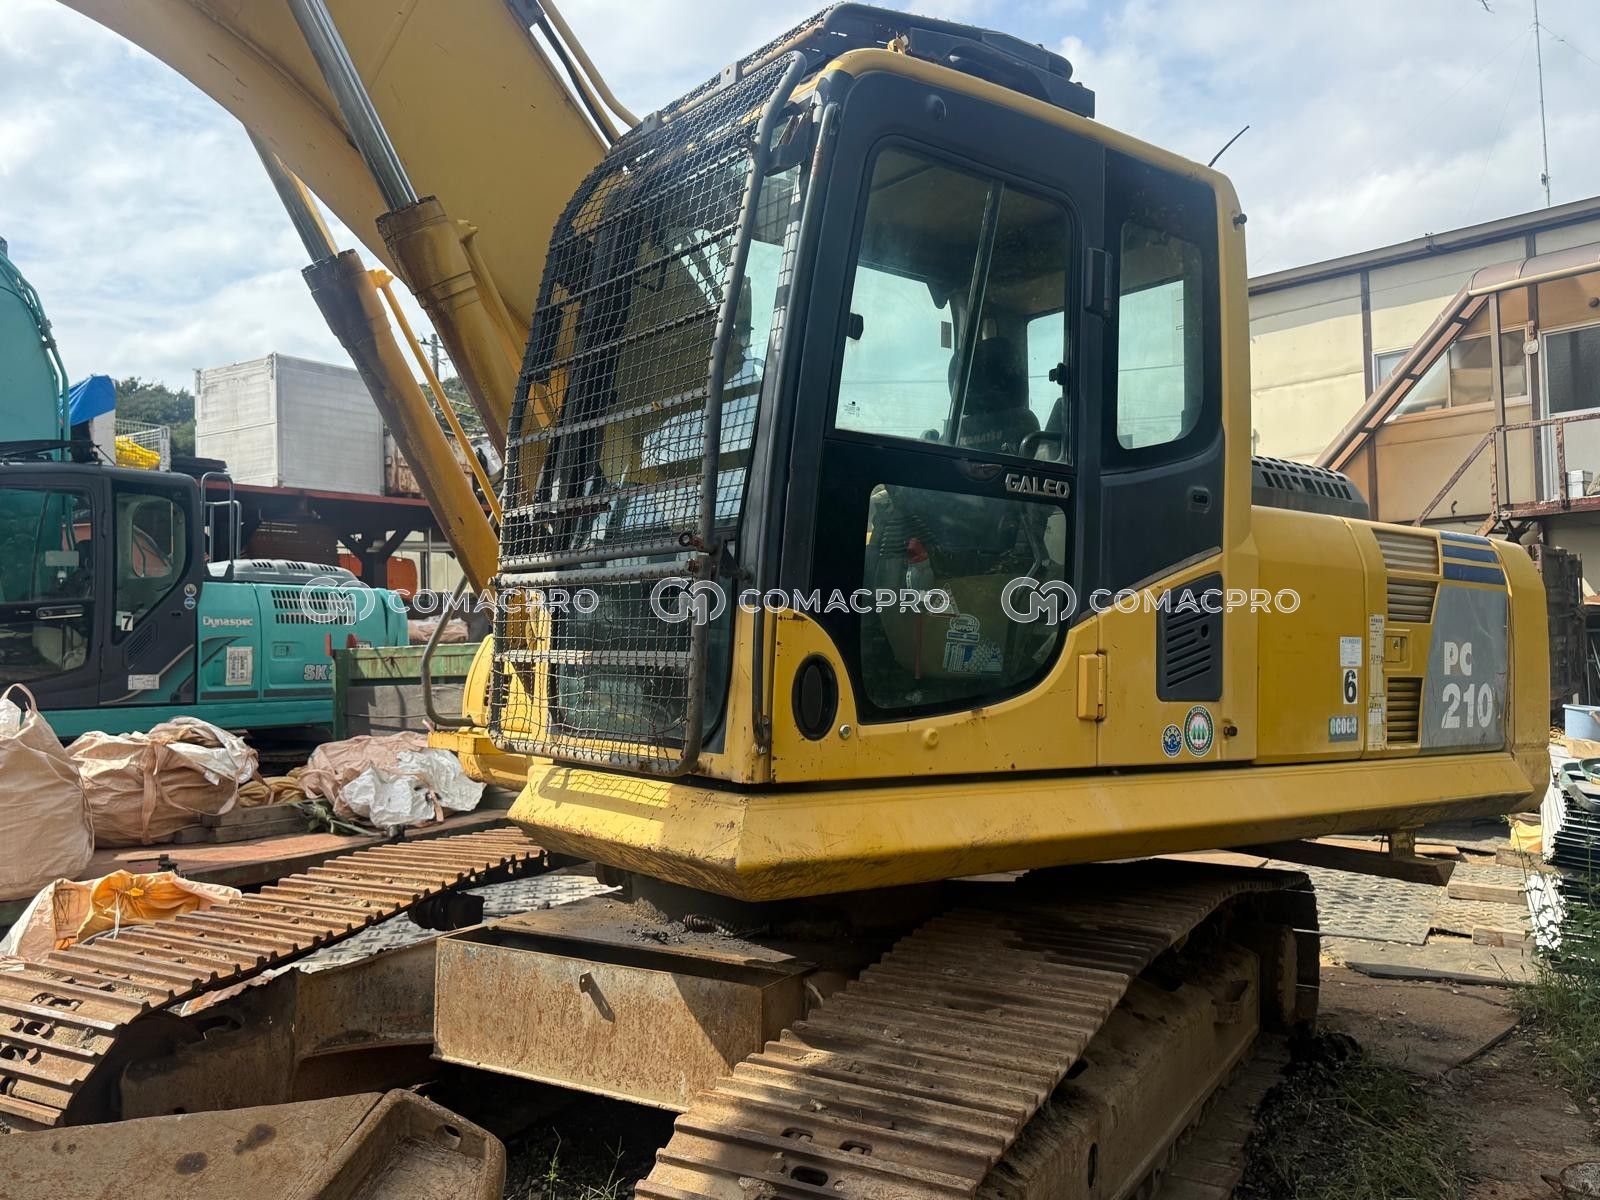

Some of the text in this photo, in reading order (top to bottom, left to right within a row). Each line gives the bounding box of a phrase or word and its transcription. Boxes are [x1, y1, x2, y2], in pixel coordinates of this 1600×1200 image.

[1005, 473, 1071, 499] GALEO
[123, 616, 133, 631] 7
[203, 616, 254, 628] Dynaspec
[1443, 641, 1473, 677] PC
[1344, 669, 1357, 703] 6
[1441, 682, 1493, 729] 210
